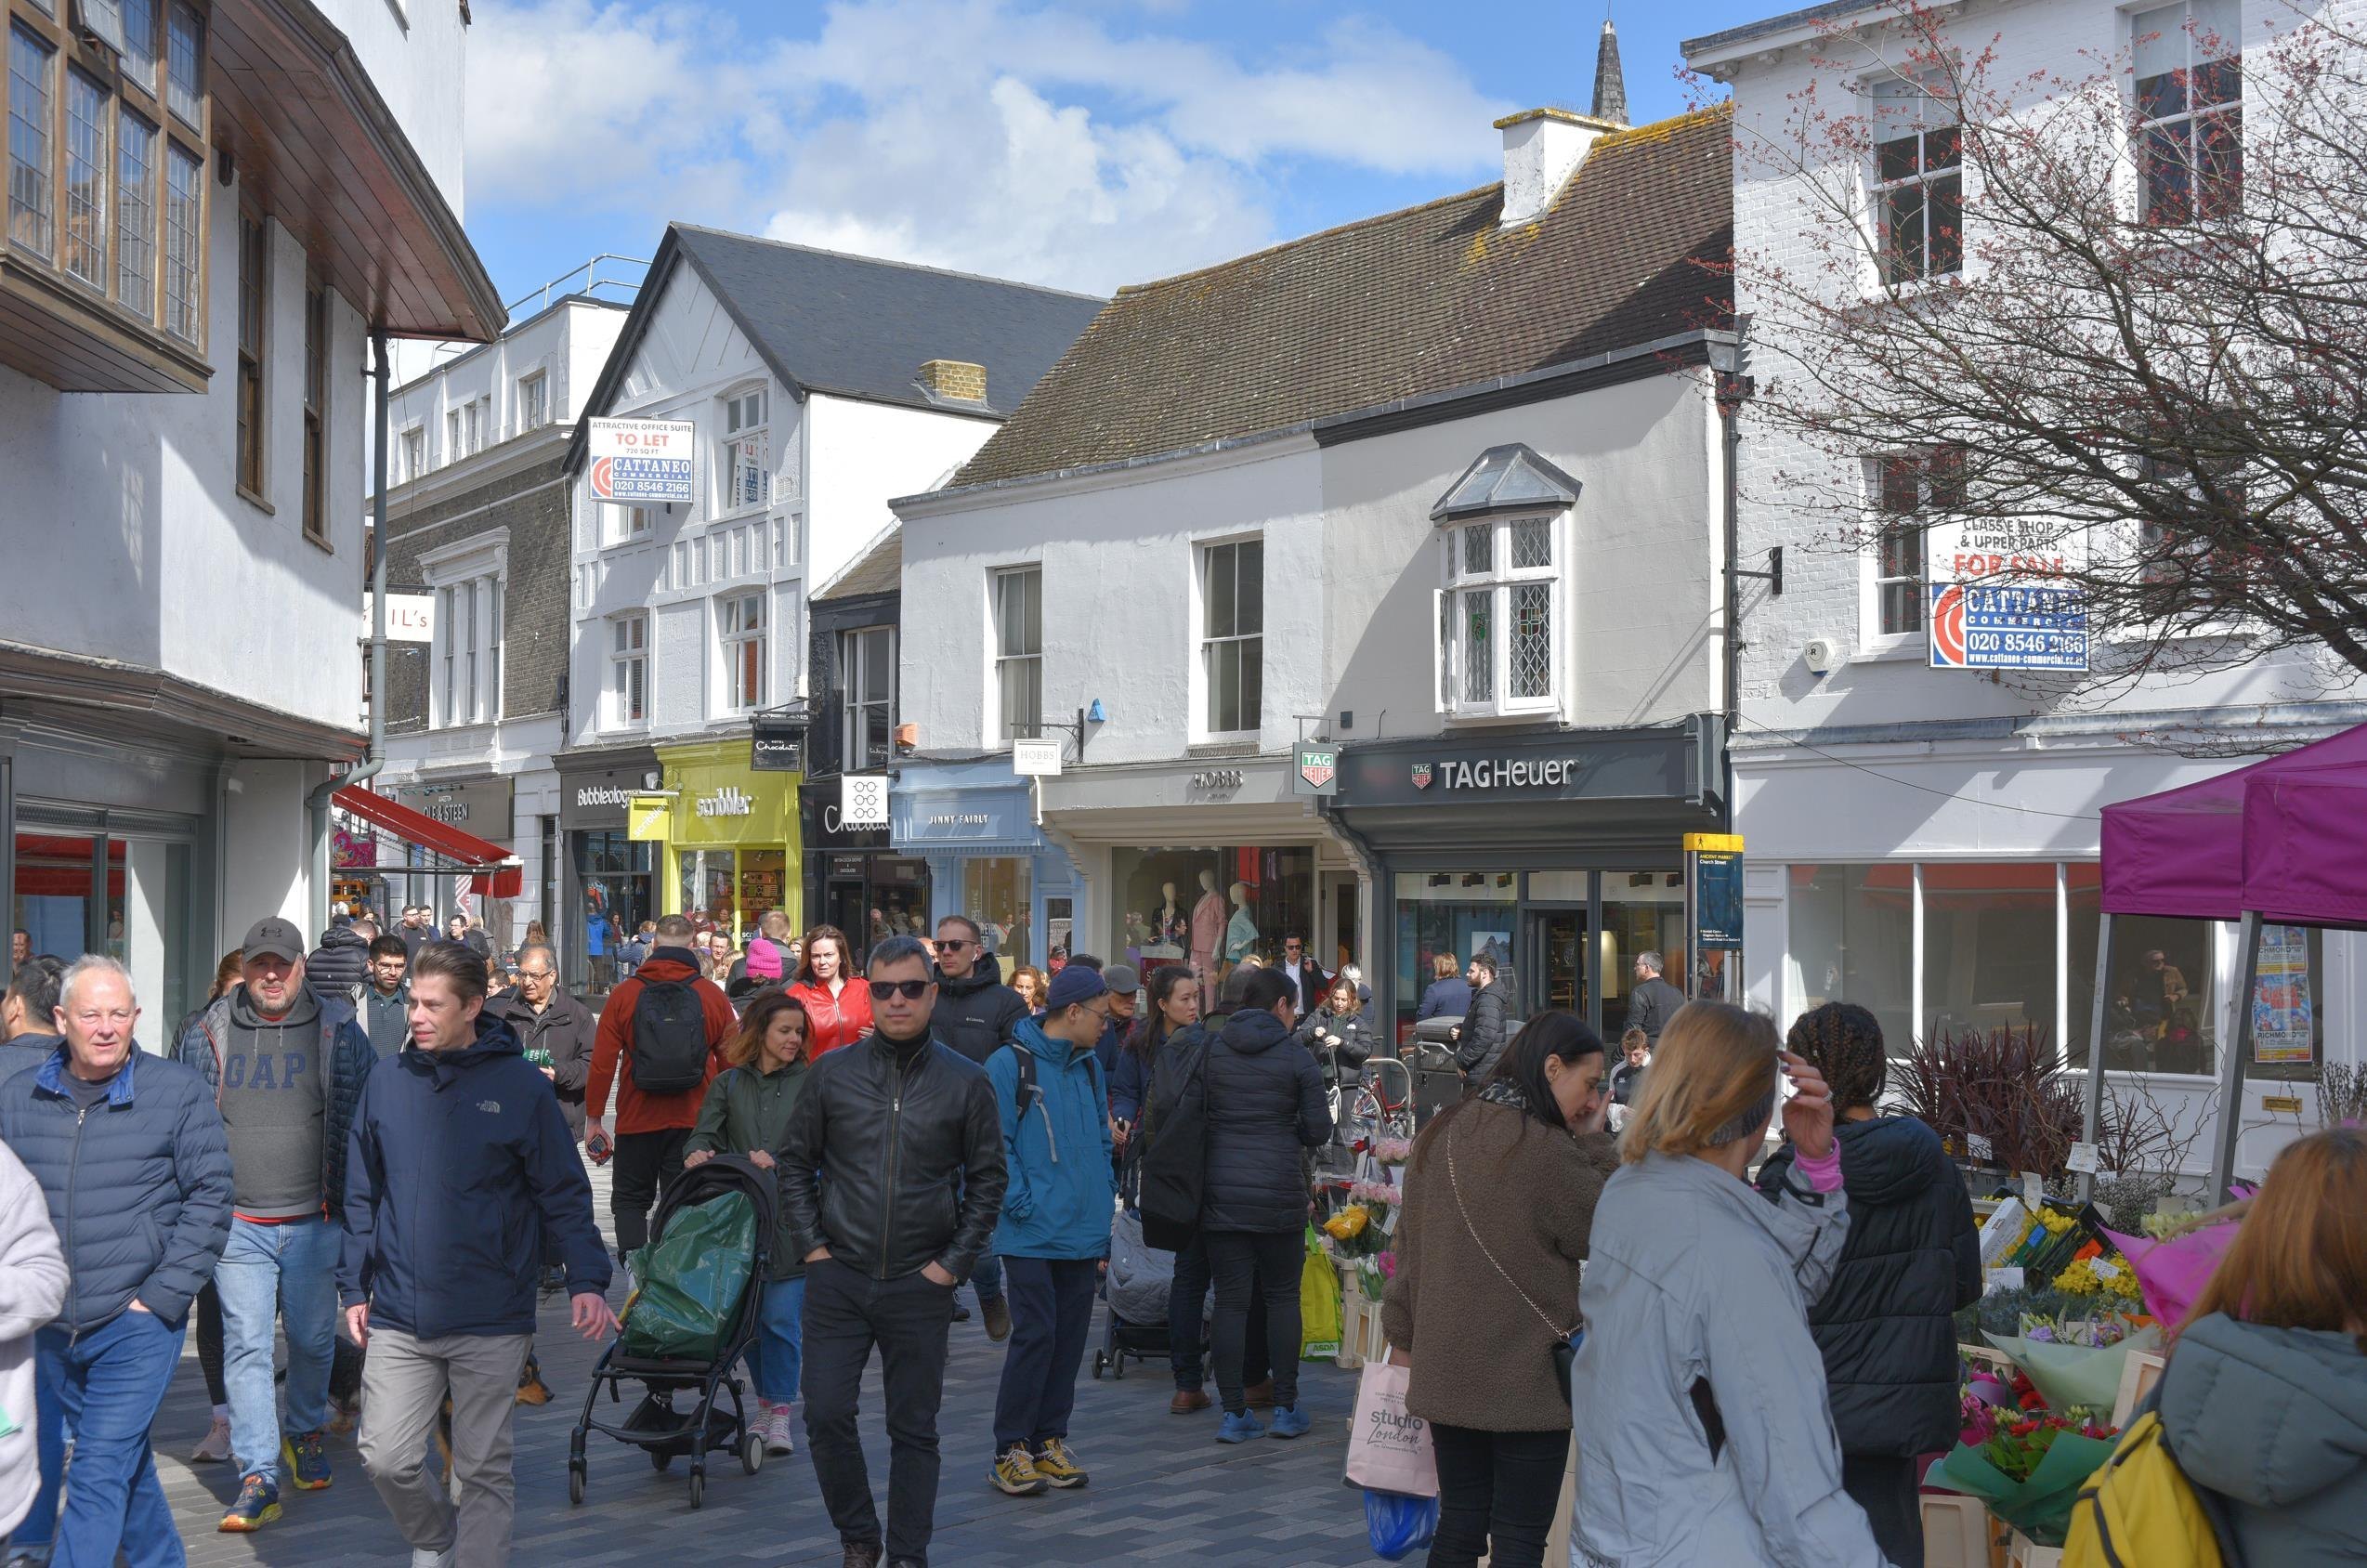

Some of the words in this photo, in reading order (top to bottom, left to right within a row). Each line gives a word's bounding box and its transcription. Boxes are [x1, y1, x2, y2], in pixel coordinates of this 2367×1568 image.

[593, 422, 639, 430] ATTRACTIVE
[615, 433, 637, 446] TO
[644, 434, 669, 447] LET
[613, 458, 690, 474] CATTANEO
[613, 472, 689, 480] COMMERCIAL
[614, 480, 634, 490] 020
[636, 481, 663, 492] 8546
[665, 482, 689, 493] 2166
[1964, 518, 2003, 531] CLASS
[2007, 520, 2014, 532] E
[2018, 520, 2054, 534] SHOP
[1960, 534, 1969, 547] &
[1975, 535, 2016, 550] UPPER
[2020, 537, 2058, 552] PARTS
[1955, 555, 2003, 576] FOR
[1968, 633, 2000, 651] 020
[2004, 634, 2046, 652] 8546
[2048, 635, 2084, 654] 2166
[1020, 751, 1055, 760] HOBBS
[1304, 754, 1331, 766] TAG
[1303, 768, 1332, 784] HEUER
[1413, 764, 1431, 774] TAG
[1195, 770, 1244, 789] HOBBS
[577, 785, 632, 809] Bubbleolog
[696, 786, 752, 817] scribbler
[444, 803, 468, 821] STEEN
[929, 815, 955, 825] JINNY
[959, 814, 988, 825] FAIRLY
[2257, 1031, 2296, 1039] RICHMOD
[225, 1052, 306, 1089] GAP
[1313, 1343, 1336, 1352] ASDA
[1370, 1409, 1423, 1431] studio
[1367, 1422, 1421, 1444] London
